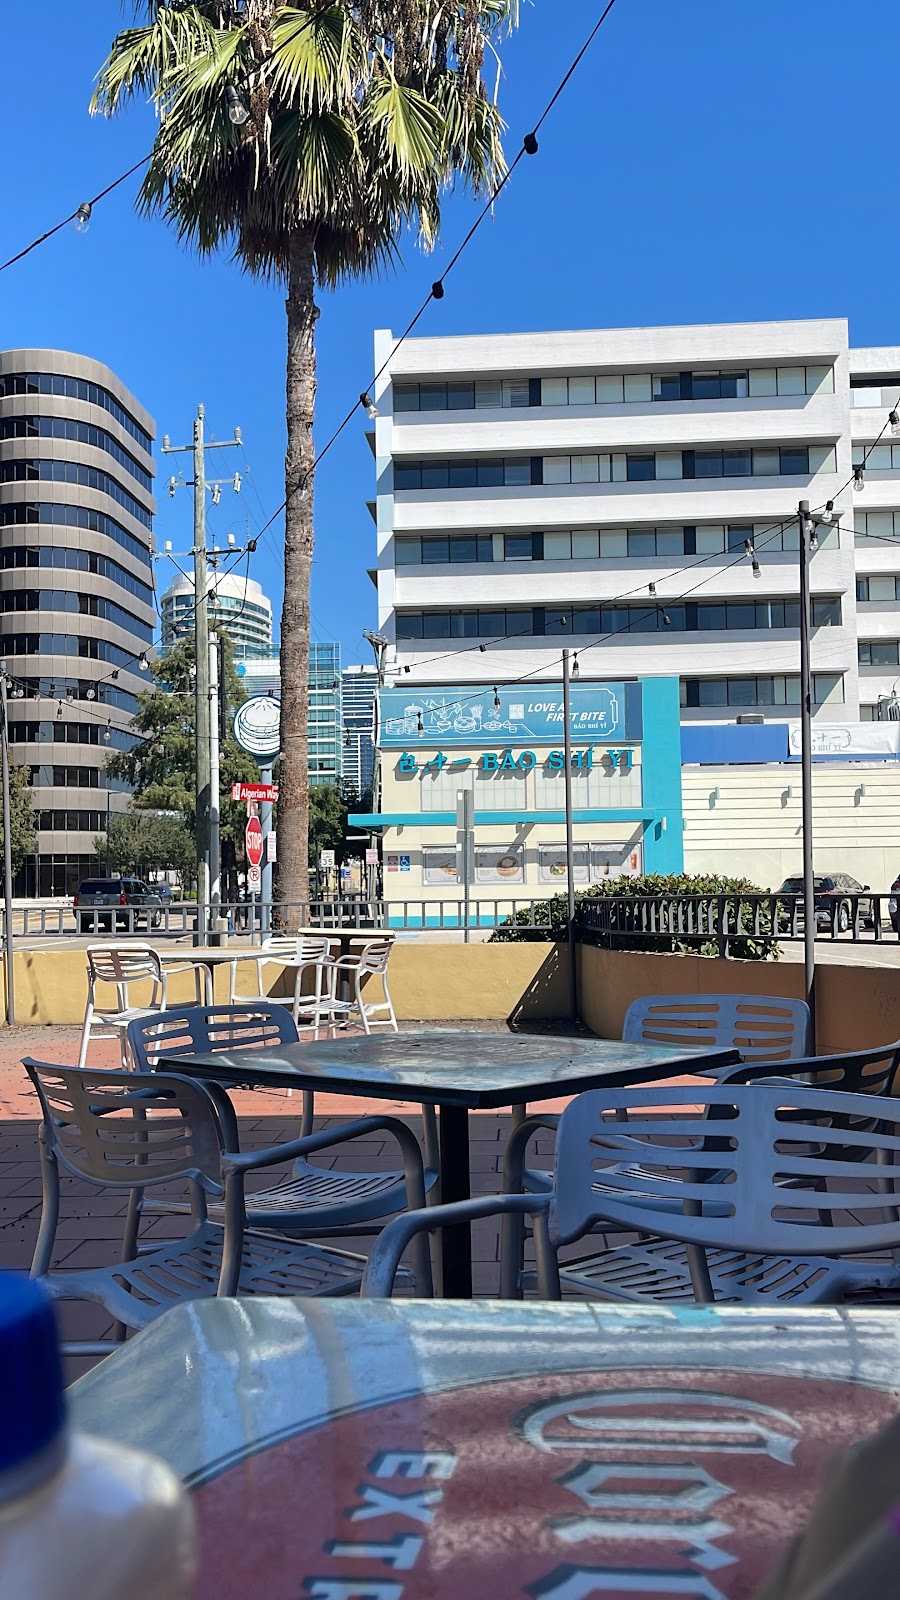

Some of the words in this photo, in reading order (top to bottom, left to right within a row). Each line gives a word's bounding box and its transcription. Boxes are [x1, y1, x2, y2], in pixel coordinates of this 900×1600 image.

[528, 703, 557, 712] LOVE
[557, 703, 573, 712] A
[546, 712, 580, 722] FIRT
[580, 711, 607, 721] BITE
[241, 787, 266, 800] Algerian
[266, 788, 279, 802] Way
[247, 831, 262, 850] STOP
[323, 858, 333, 866] 35
